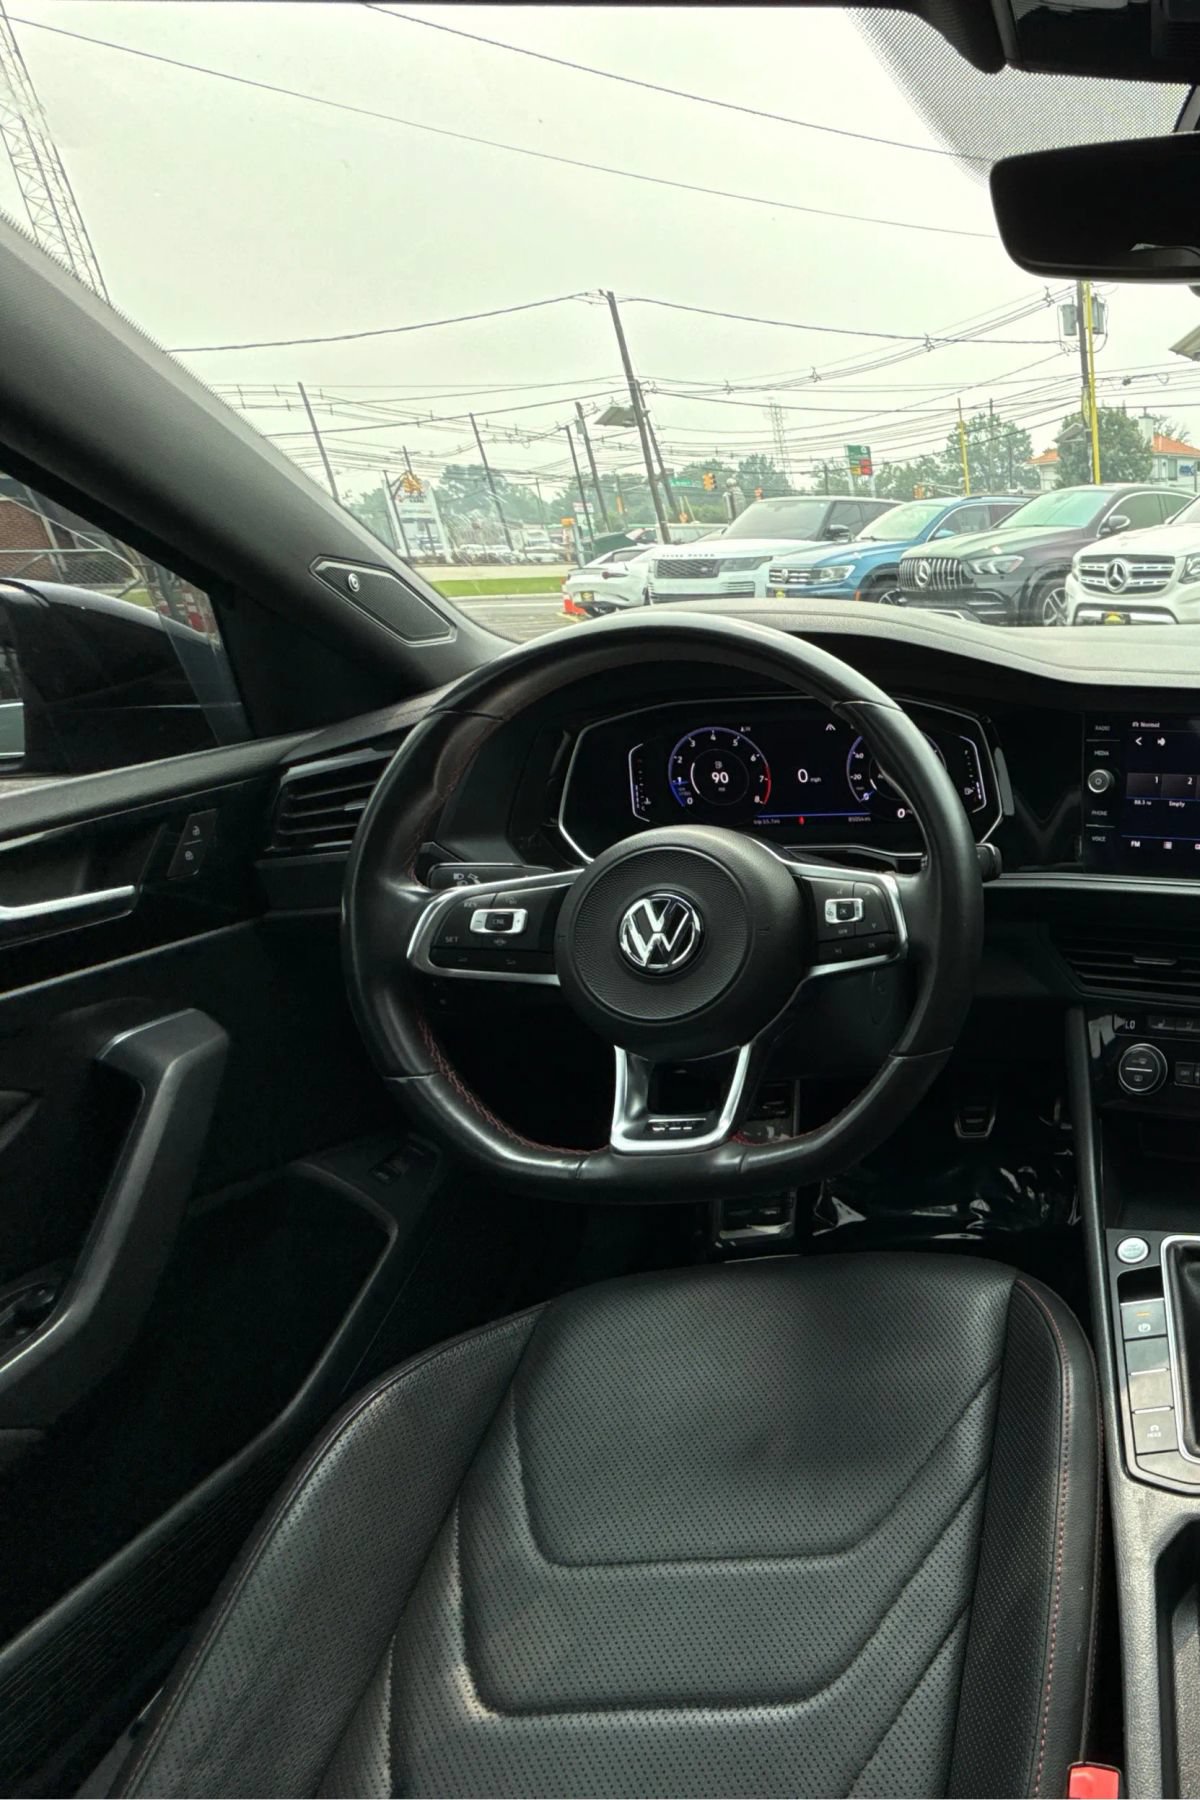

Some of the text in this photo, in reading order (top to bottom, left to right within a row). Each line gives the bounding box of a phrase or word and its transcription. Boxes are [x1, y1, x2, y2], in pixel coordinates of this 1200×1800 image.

[711, 771, 729, 784] 90
[797, 768, 808, 783] 0
[1187, 777, 1193, 785] 2
[686, 797, 693, 805] 0
[1168, 800, 1185, 808] Empty
[1130, 840, 1141, 848] FM
[1125, 1020, 1136, 1030] LO
